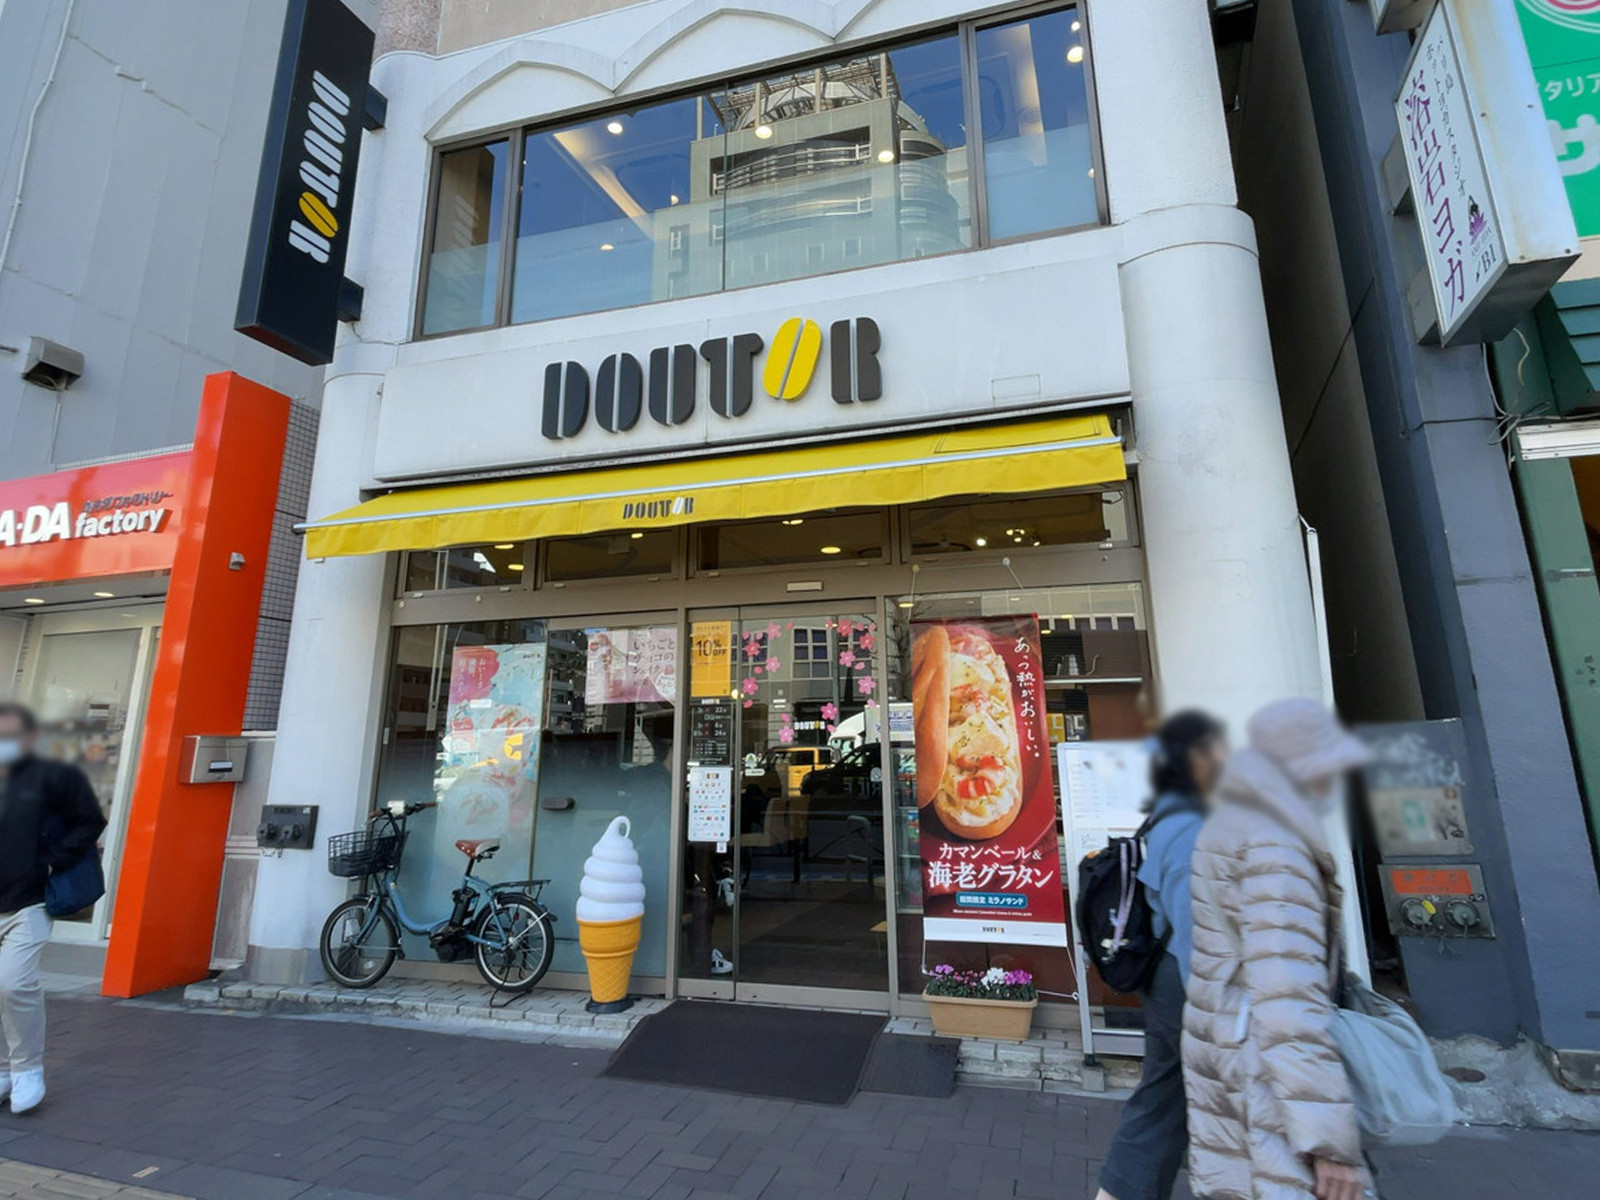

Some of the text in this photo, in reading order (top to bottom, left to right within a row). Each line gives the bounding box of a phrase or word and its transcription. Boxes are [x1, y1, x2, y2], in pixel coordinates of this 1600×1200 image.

[288, 69, 351, 264] DOUTOR
[1404, 68, 1465, 319] 溶岩ヨガ
[541, 316, 883, 440] DOUTOR
[75, 508, 165, 538] factory
[622, 496, 694, 520] DOUTOR
[927, 860, 1055, 890] 海老グラタン
[988, 896, 1024, 906] ミラノサンド
